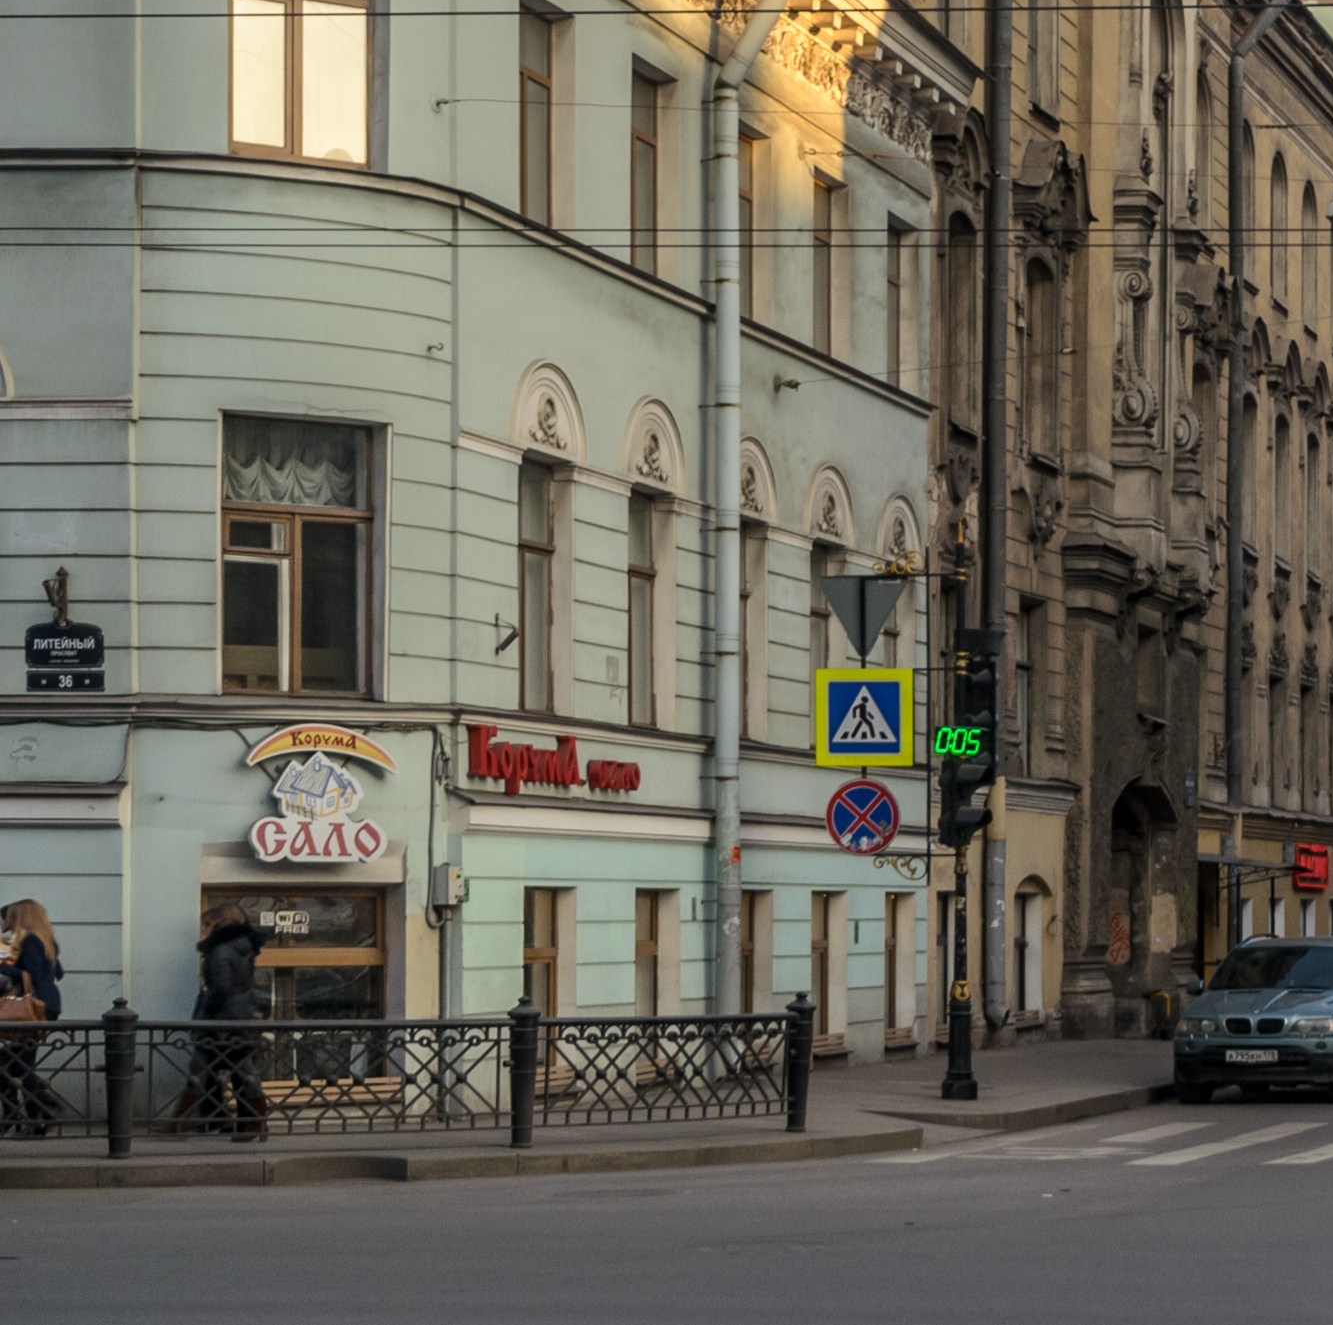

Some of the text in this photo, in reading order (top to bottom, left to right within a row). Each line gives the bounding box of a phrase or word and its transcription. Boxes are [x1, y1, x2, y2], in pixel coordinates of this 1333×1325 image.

[33, 636, 96, 650] ЛИТЕЙНЫЙ
[58, 674, 73, 688] 36
[275, 925, 310, 934] FREE
